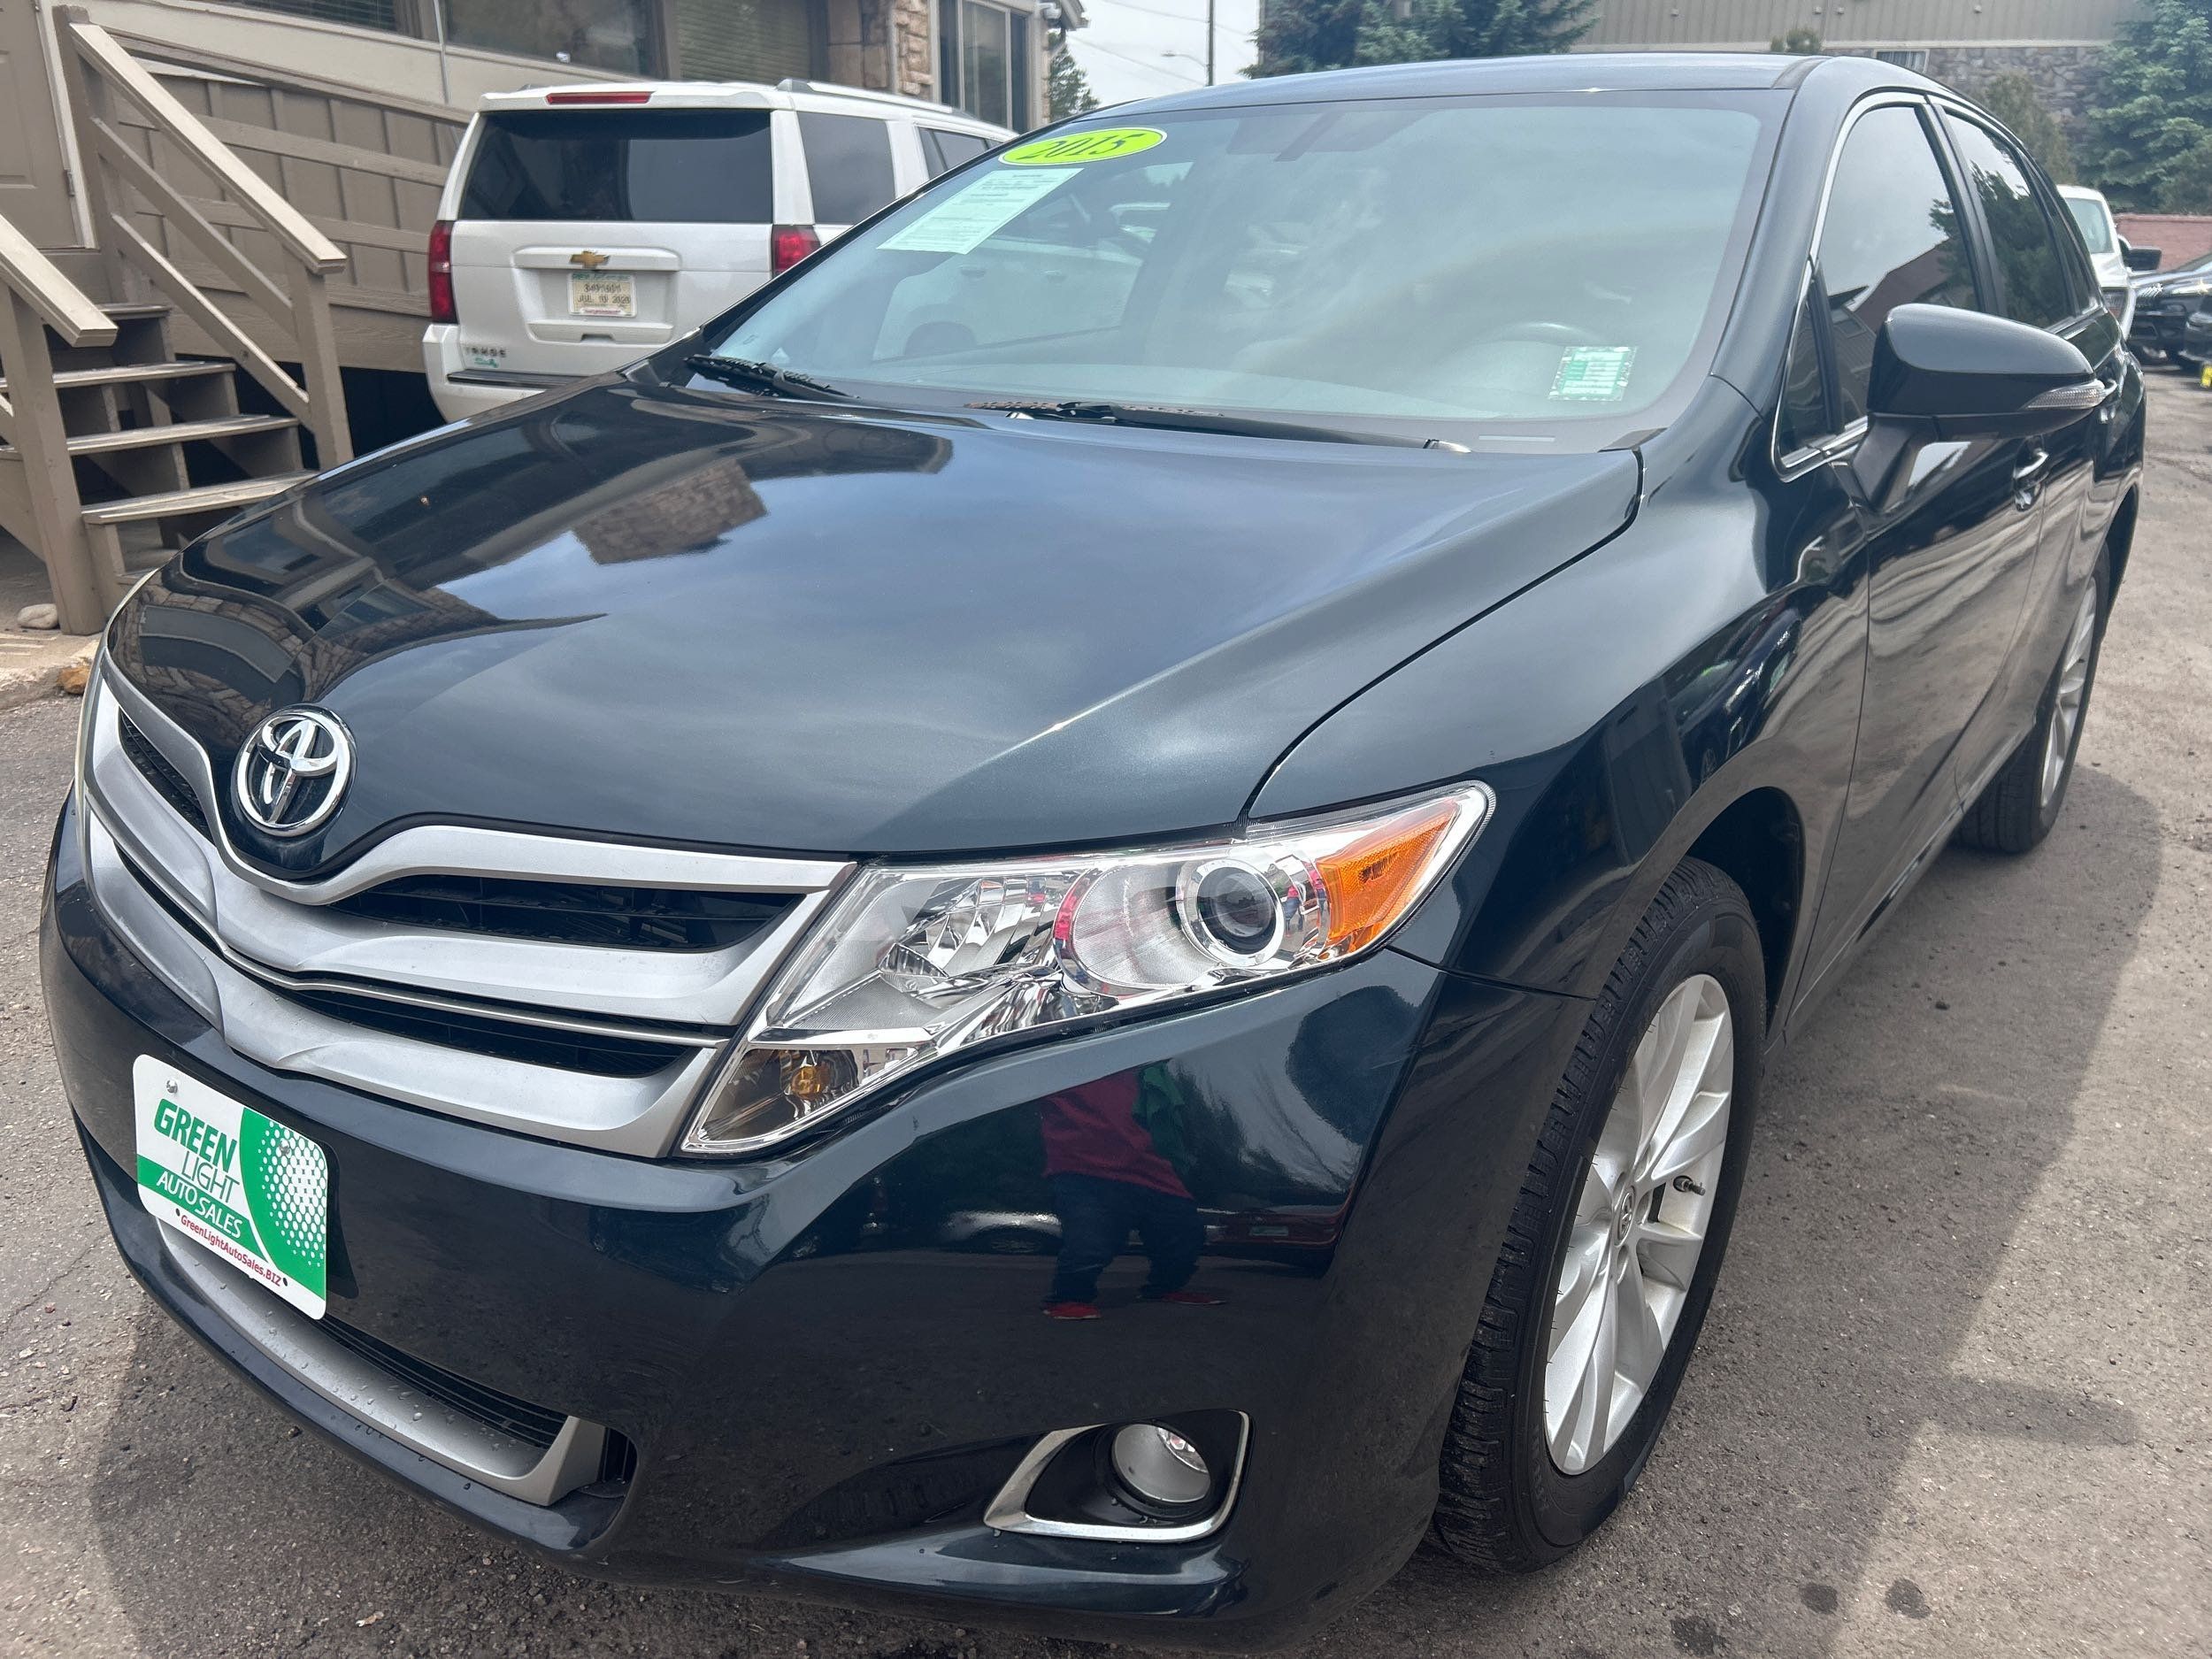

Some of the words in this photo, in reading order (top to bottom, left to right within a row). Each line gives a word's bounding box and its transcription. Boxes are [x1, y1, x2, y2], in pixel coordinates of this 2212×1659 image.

[1018, 133, 1148, 161] 2015
[154, 1098, 237, 1173] GREEN
[156, 1171, 198, 1205] AUTO
[194, 1196, 243, 1239] SALES
[181, 1150, 240, 1203] LIGHT
[180, 1214, 282, 1287] GreenLightAutoSales.BIZ
